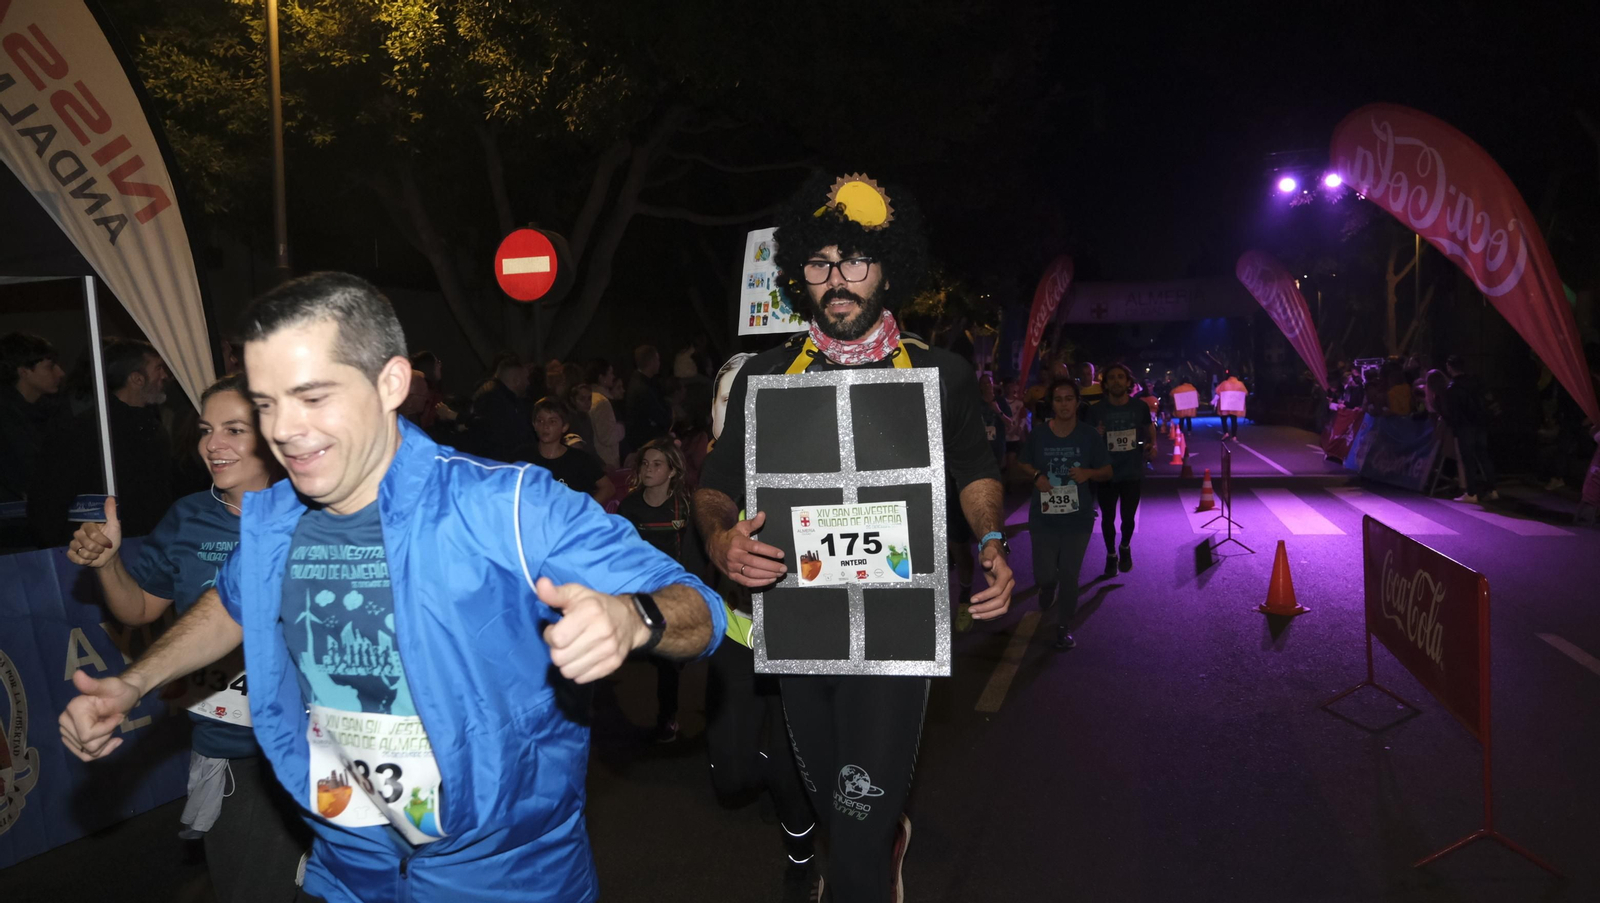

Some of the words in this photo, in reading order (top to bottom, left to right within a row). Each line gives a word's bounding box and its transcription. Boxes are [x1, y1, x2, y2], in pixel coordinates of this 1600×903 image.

[1049, 495, 1070, 504] 438
[816, 508, 831, 518] XIV
[832, 508, 850, 518] SAN
[852, 504, 899, 516] SILVESTRE
[818, 518, 848, 527] CIUDAD
[850, 517, 861, 526] DE
[216, 541, 233, 551] SAN
[820, 531, 883, 557] 175
[840, 558, 867, 566] ANTERO
[291, 564, 326, 579] CIUDAD
[327, 564, 340, 579] DE
[1381, 549, 1446, 672] Coca-Cola
[342, 717, 362, 732] SAN
[13, 710, 23, 757] LIBERTAD
